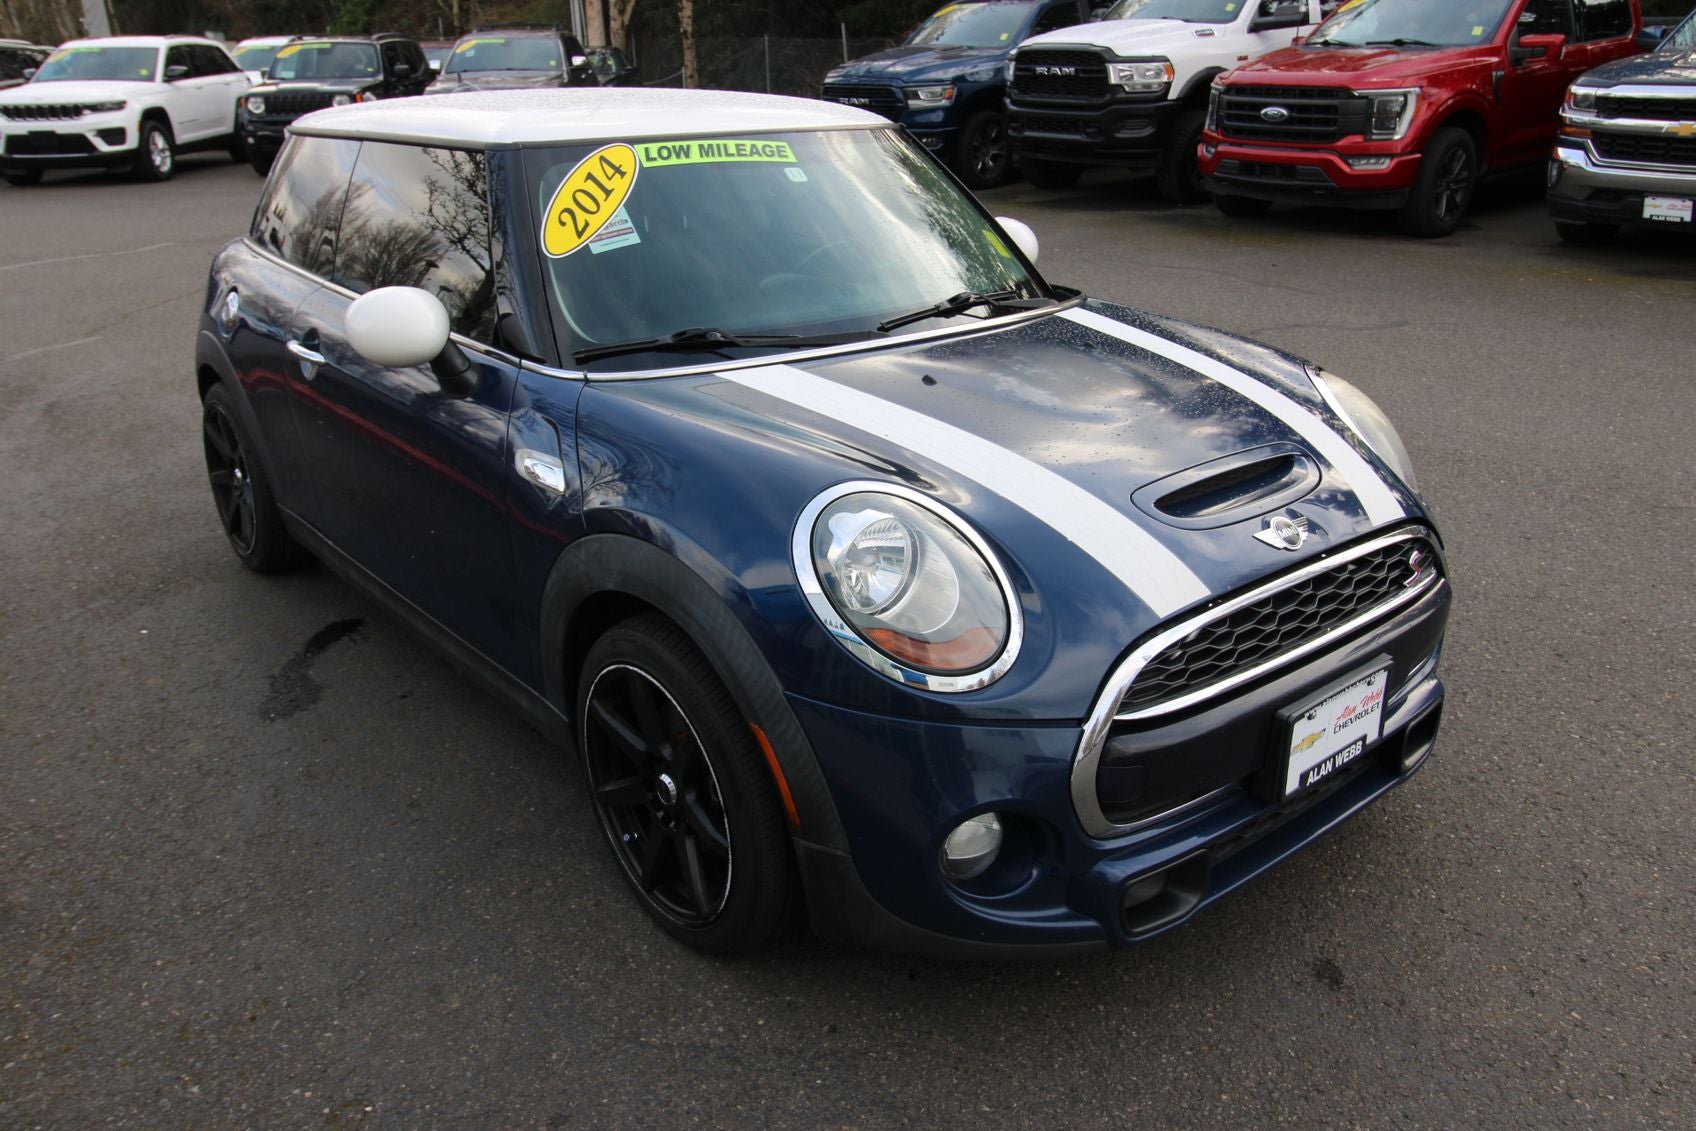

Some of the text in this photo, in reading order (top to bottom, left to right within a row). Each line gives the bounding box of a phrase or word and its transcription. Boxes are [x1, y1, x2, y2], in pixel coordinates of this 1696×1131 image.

[1035, 66, 1075, 76] RAM
[839, 97, 870, 105] RAM
[644, 143, 790, 162] LOW MILEAGE
[558, 155, 627, 239] 2014
[1277, 526, 1298, 538] MINI
[1333, 700, 1381, 734] CHEVROLET
[1306, 740, 1363, 787] ALAN WEBB
